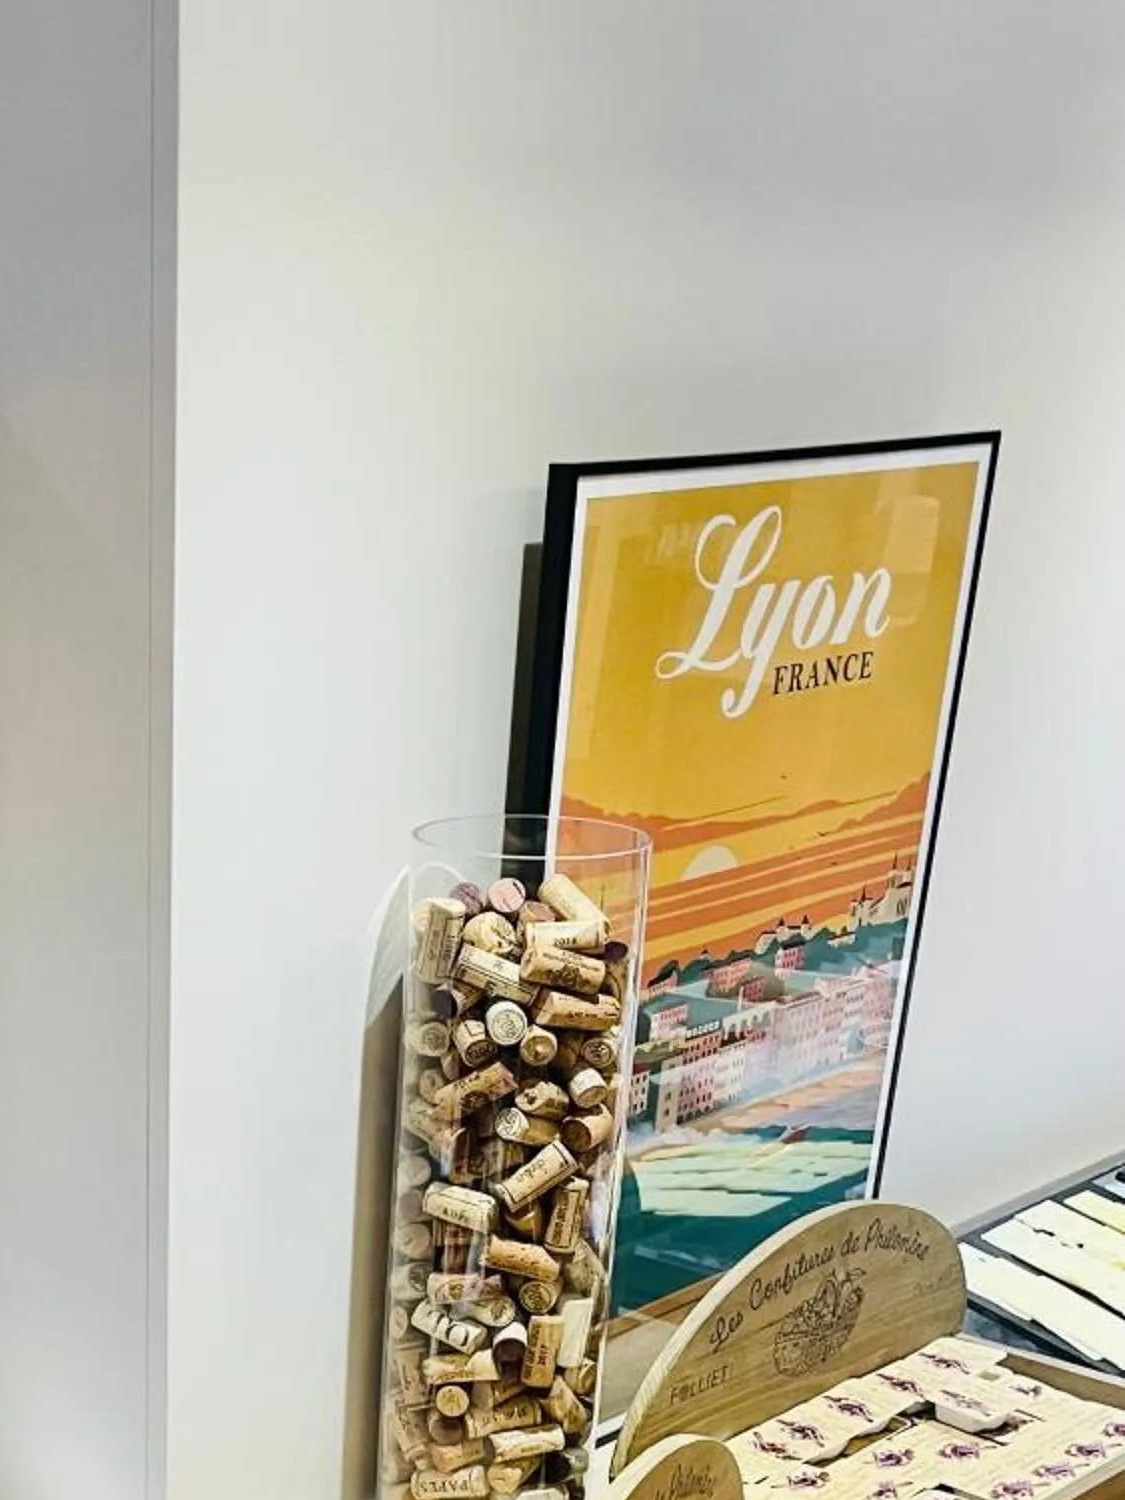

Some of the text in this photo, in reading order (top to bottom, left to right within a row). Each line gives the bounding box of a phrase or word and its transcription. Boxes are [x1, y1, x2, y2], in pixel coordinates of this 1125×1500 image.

[656, 505, 893, 718] Lyon
[773, 651, 874, 696] FRANCE
[839, 1231, 861, 1259] de
